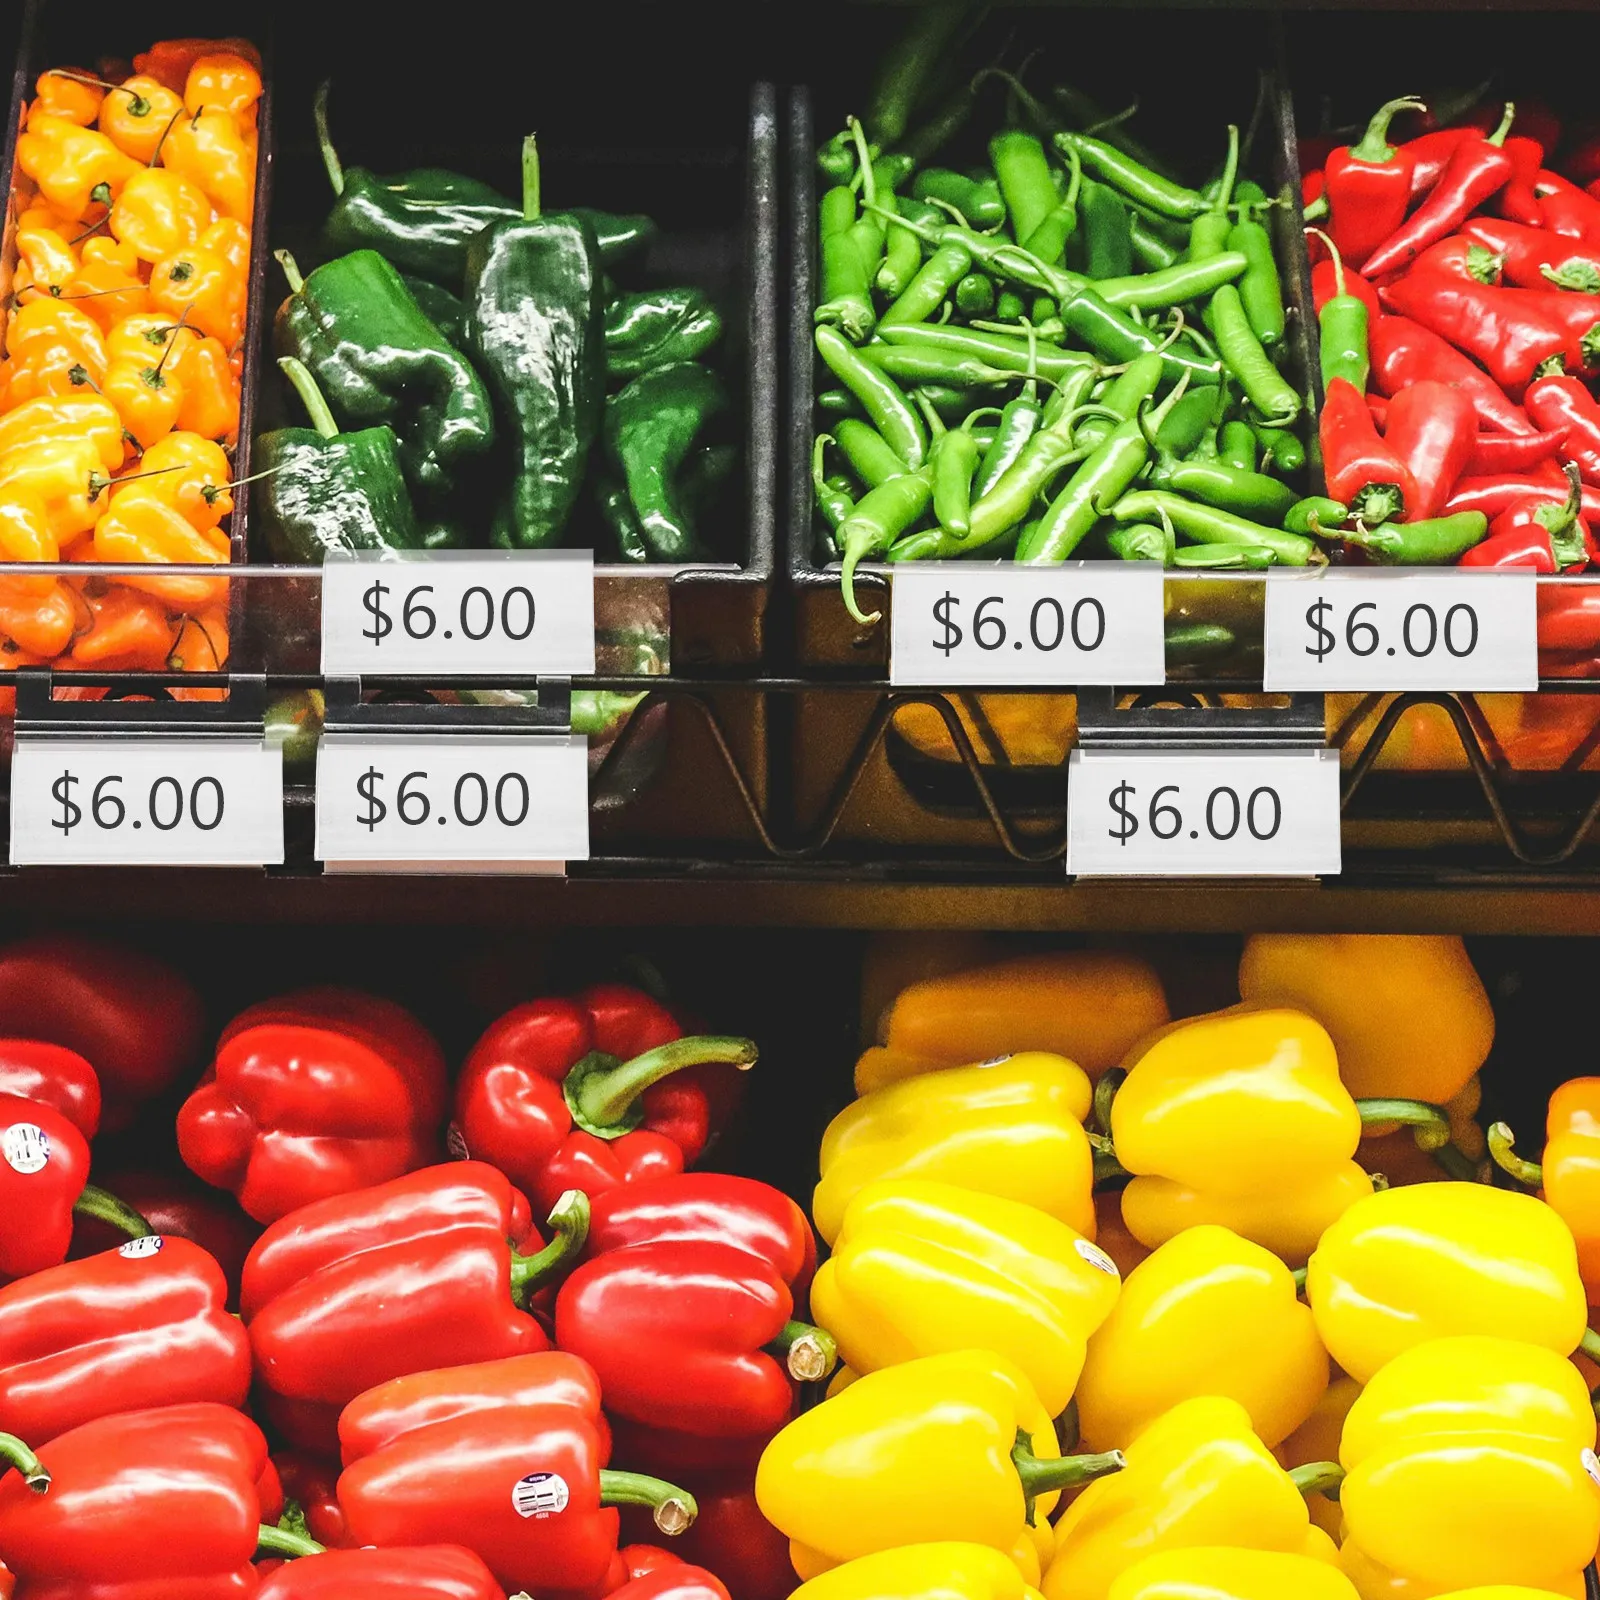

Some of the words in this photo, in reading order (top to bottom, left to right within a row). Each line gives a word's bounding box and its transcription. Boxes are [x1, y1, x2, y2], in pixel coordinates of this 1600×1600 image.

[363, 580, 535, 646] $6.00
[933, 591, 1105, 657] $6.00
[1306, 597, 1478, 663] $6.00
[52, 770, 224, 836] $6.00
[357, 766, 529, 832] $6.00
[1109, 780, 1281, 846] $6.00
